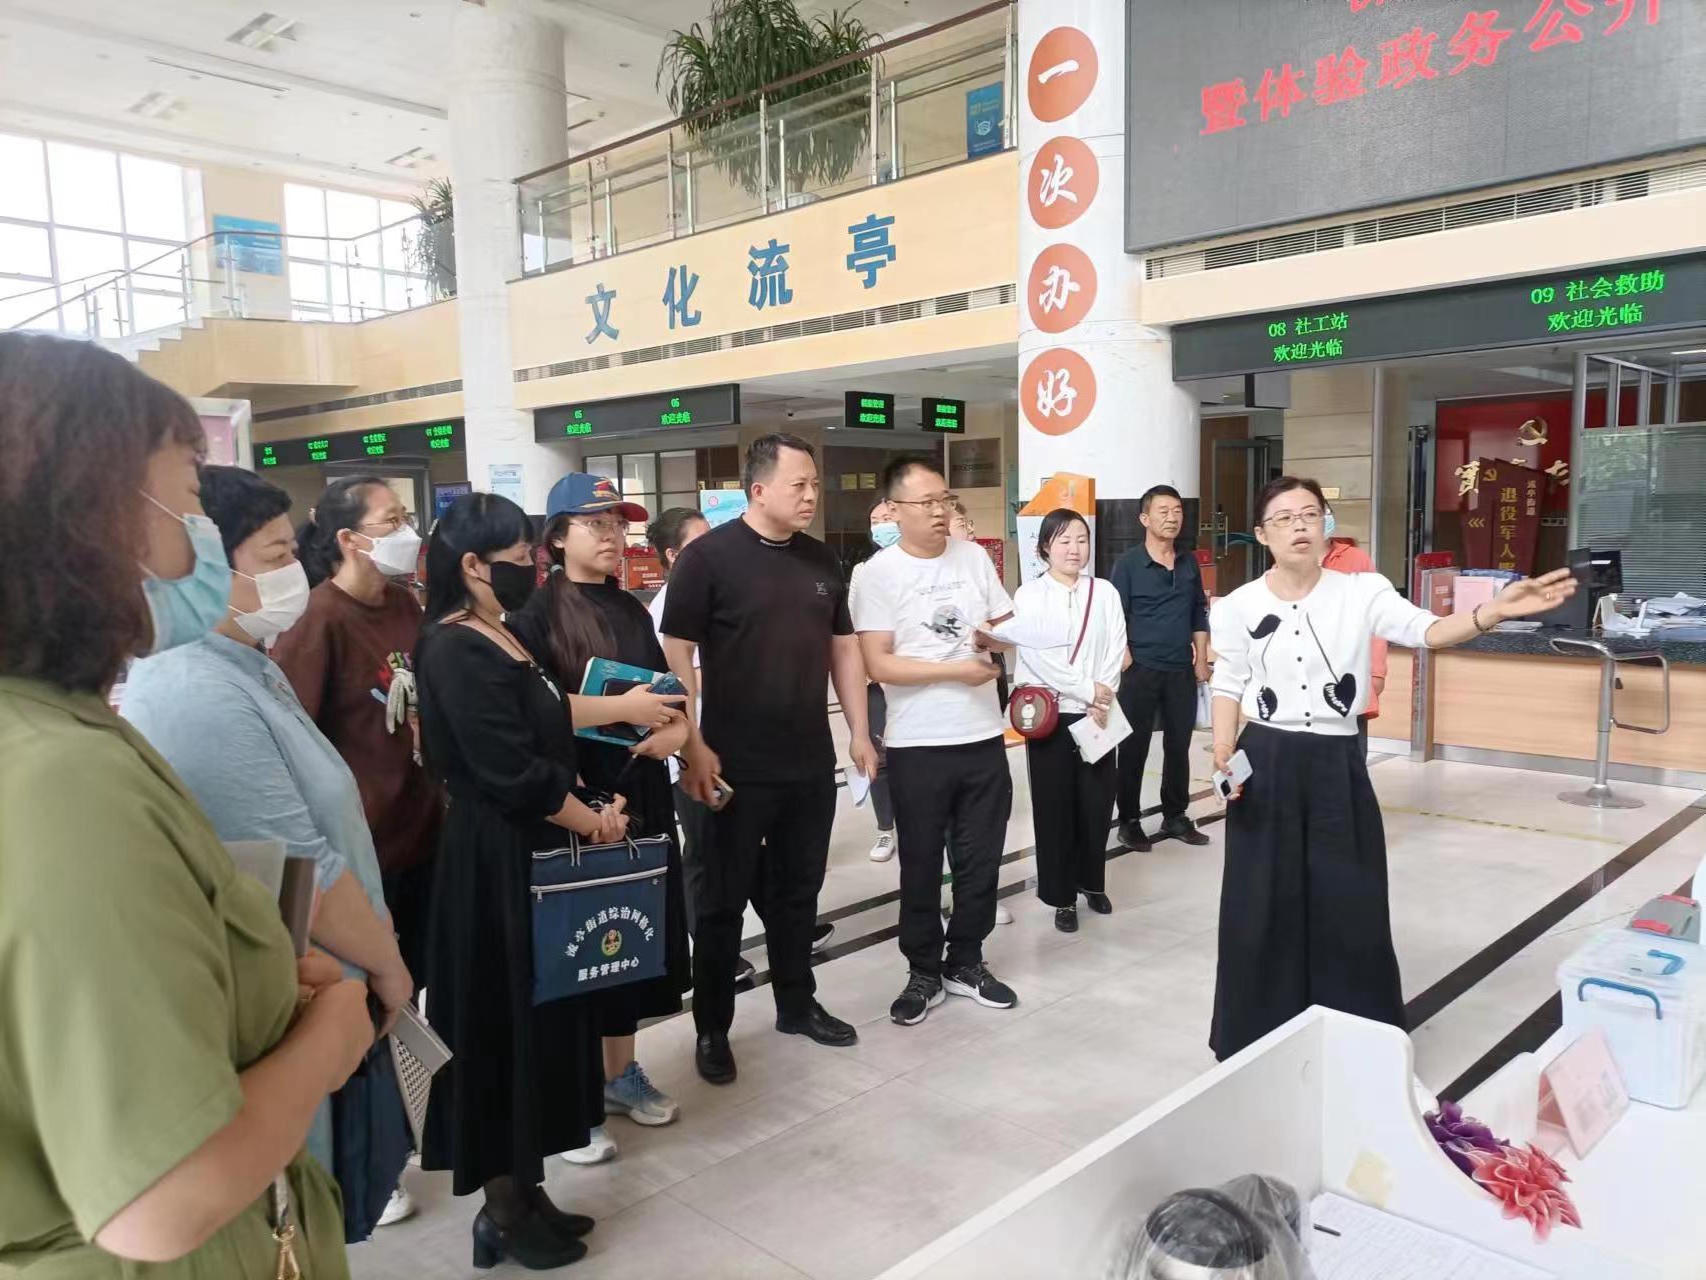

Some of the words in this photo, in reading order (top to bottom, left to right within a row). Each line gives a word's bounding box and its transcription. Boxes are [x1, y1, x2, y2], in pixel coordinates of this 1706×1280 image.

[1036, 59, 1081, 418] 一次办好
[585, 213, 897, 345] 文化流亭
[1530, 287, 1555, 305] 09
[1565, 269, 1665, 302] 社会救助
[1268, 322, 1287, 338] 08
[1295, 311, 1350, 335] 社工站
[1548, 302, 1644, 332] 欢迎光临
[1273, 338, 1344, 363] 欢迎光临
[577, 957, 640, 981] 服务管理中心
